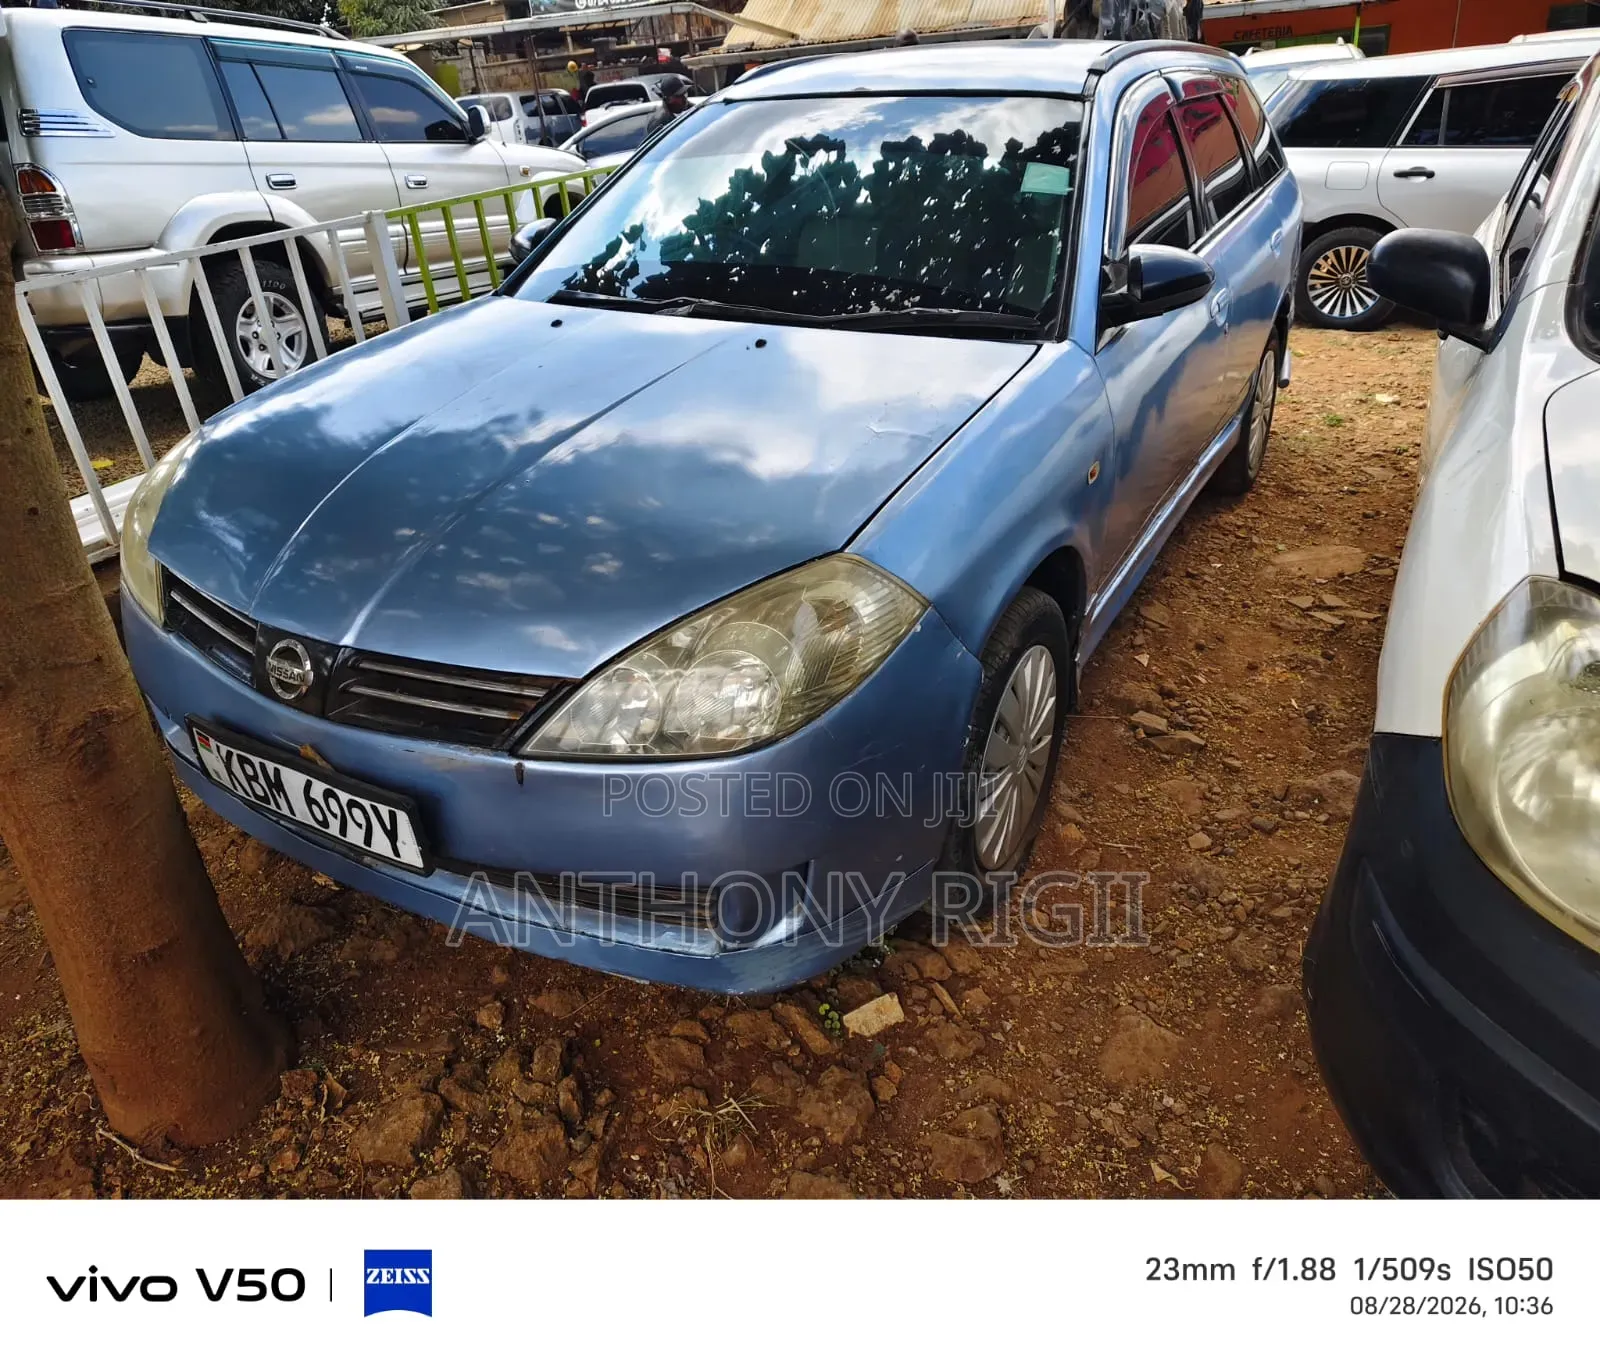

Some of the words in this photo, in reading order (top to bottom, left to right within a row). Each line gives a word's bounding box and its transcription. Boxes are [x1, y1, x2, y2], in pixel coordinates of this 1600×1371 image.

[268, 661, 306, 682] NISSAN
[216, 744, 297, 817] KBM
[303, 779, 401, 859] 699Y
